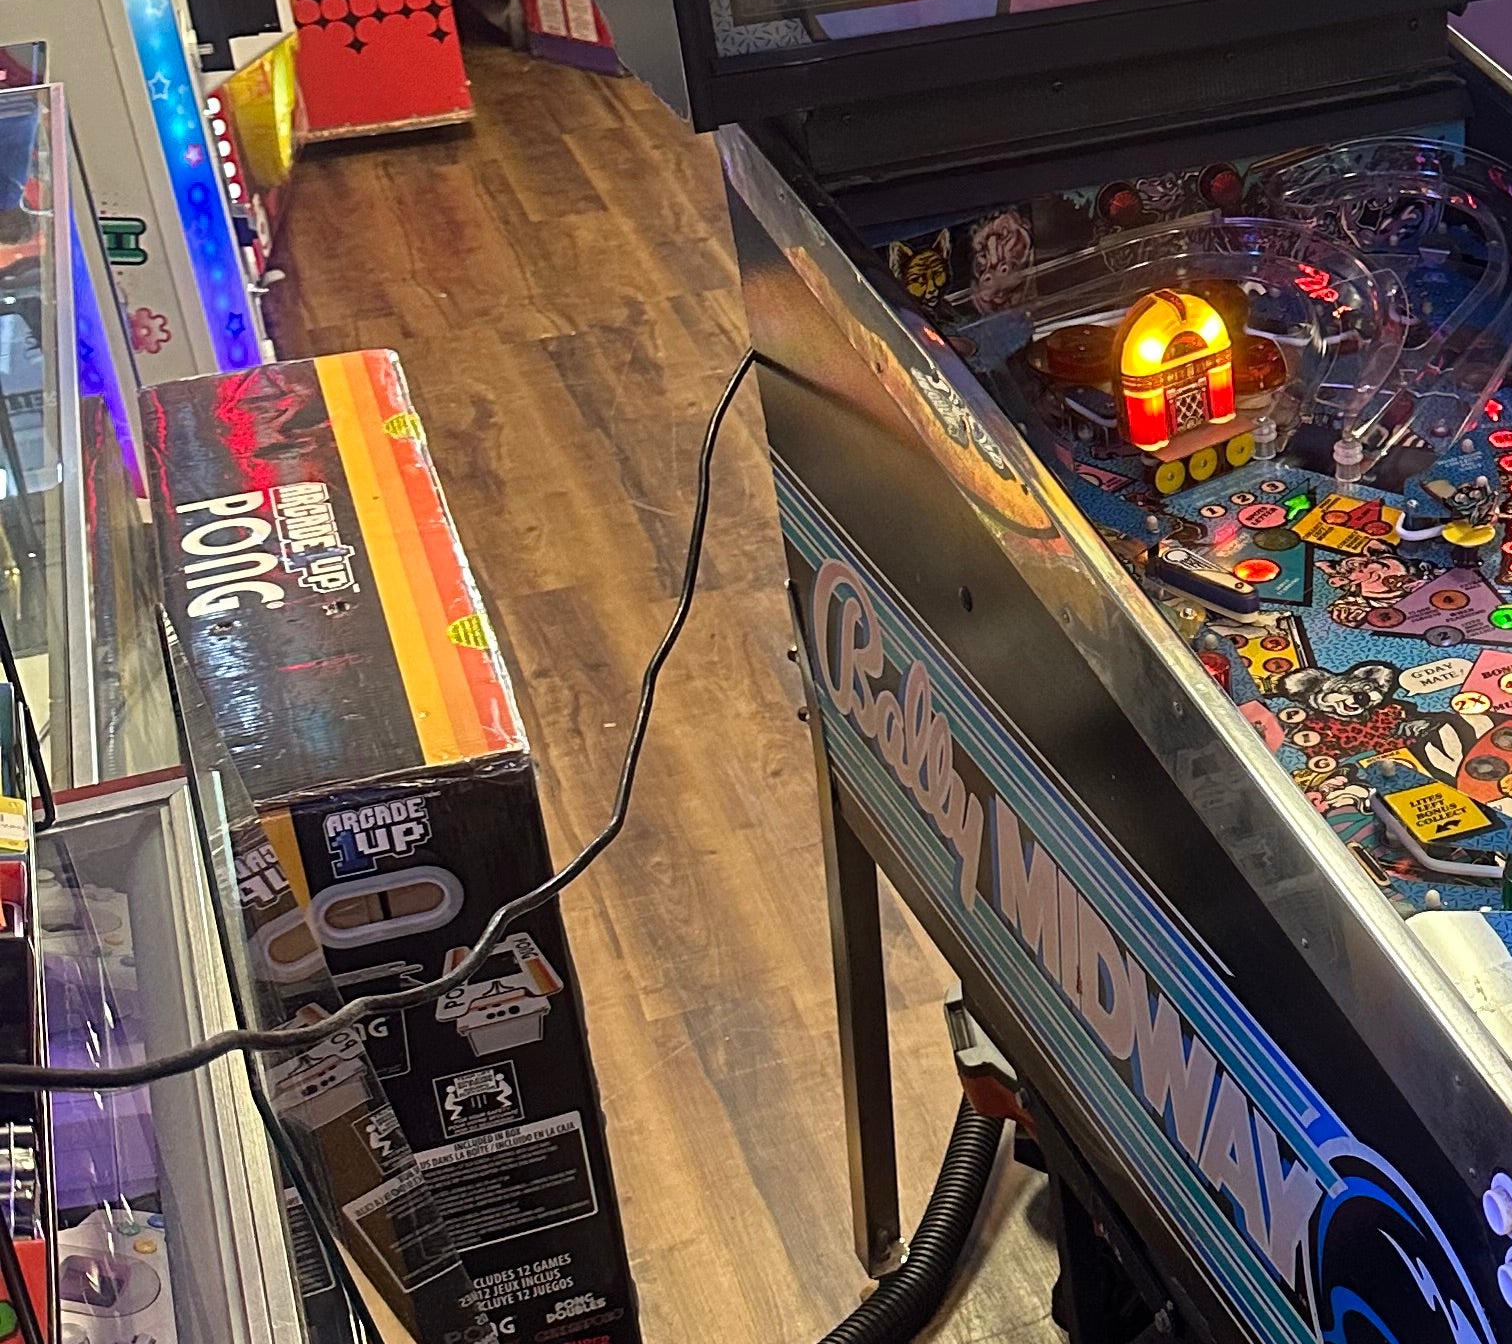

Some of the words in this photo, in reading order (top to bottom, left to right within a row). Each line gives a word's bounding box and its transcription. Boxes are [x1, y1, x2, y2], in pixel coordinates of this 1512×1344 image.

[278, 484, 342, 551] ARCADE
[175, 489, 284, 618] PONG
[1411, 661, 1454, 680] G'DAY
[1420, 667, 1465, 688] MATE!
[1455, 694, 1487, 712] 2X
[810, 557, 982, 909] Bally
[1315, 757, 1330, 770] G
[1409, 792, 1443, 808] LITES
[1416, 799, 1445, 813] LEFT
[1416, 801, 1458, 821] BONUS
[325, 797, 426, 837] ARCADE
[1415, 806, 1468, 828] COLLECT
[334, 821, 426, 873] 1UP
[993, 797, 1322, 1284] MIDWAY
[453, 1133, 493, 1152] INCLUDED
[504, 1127, 522, 1138] BOX
[474, 1268, 516, 1290] CLUDES
[516, 1264, 531, 1277] 12
[532, 1253, 573, 1273] GAMES
[492, 1280, 520, 1297] JEUX
[521, 1269, 561, 1288] INCLUS
[481, 1294, 515, 1312] CLUYE
[516, 1289, 530, 1302] 12
[531, 1276, 575, 1298] JUEGOS
